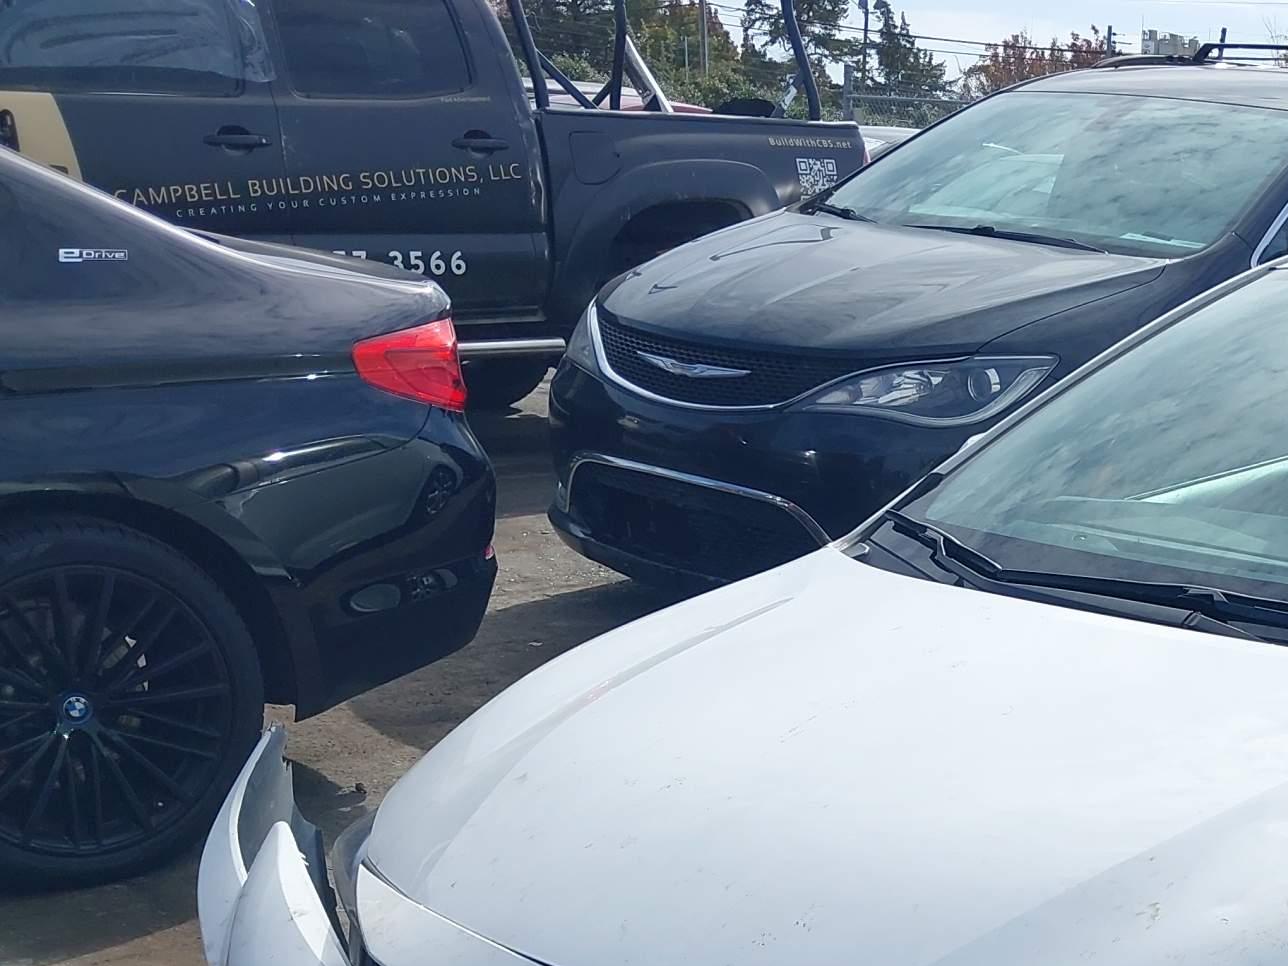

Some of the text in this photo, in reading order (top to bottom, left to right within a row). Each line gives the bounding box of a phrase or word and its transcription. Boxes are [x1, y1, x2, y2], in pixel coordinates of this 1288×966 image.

[113, 163, 522, 207] CAMPBELL BUILDING SOLUTIONS, LLC
[176, 187, 481, 218] CREATING YOUR CUSTOM EXPRESSION
